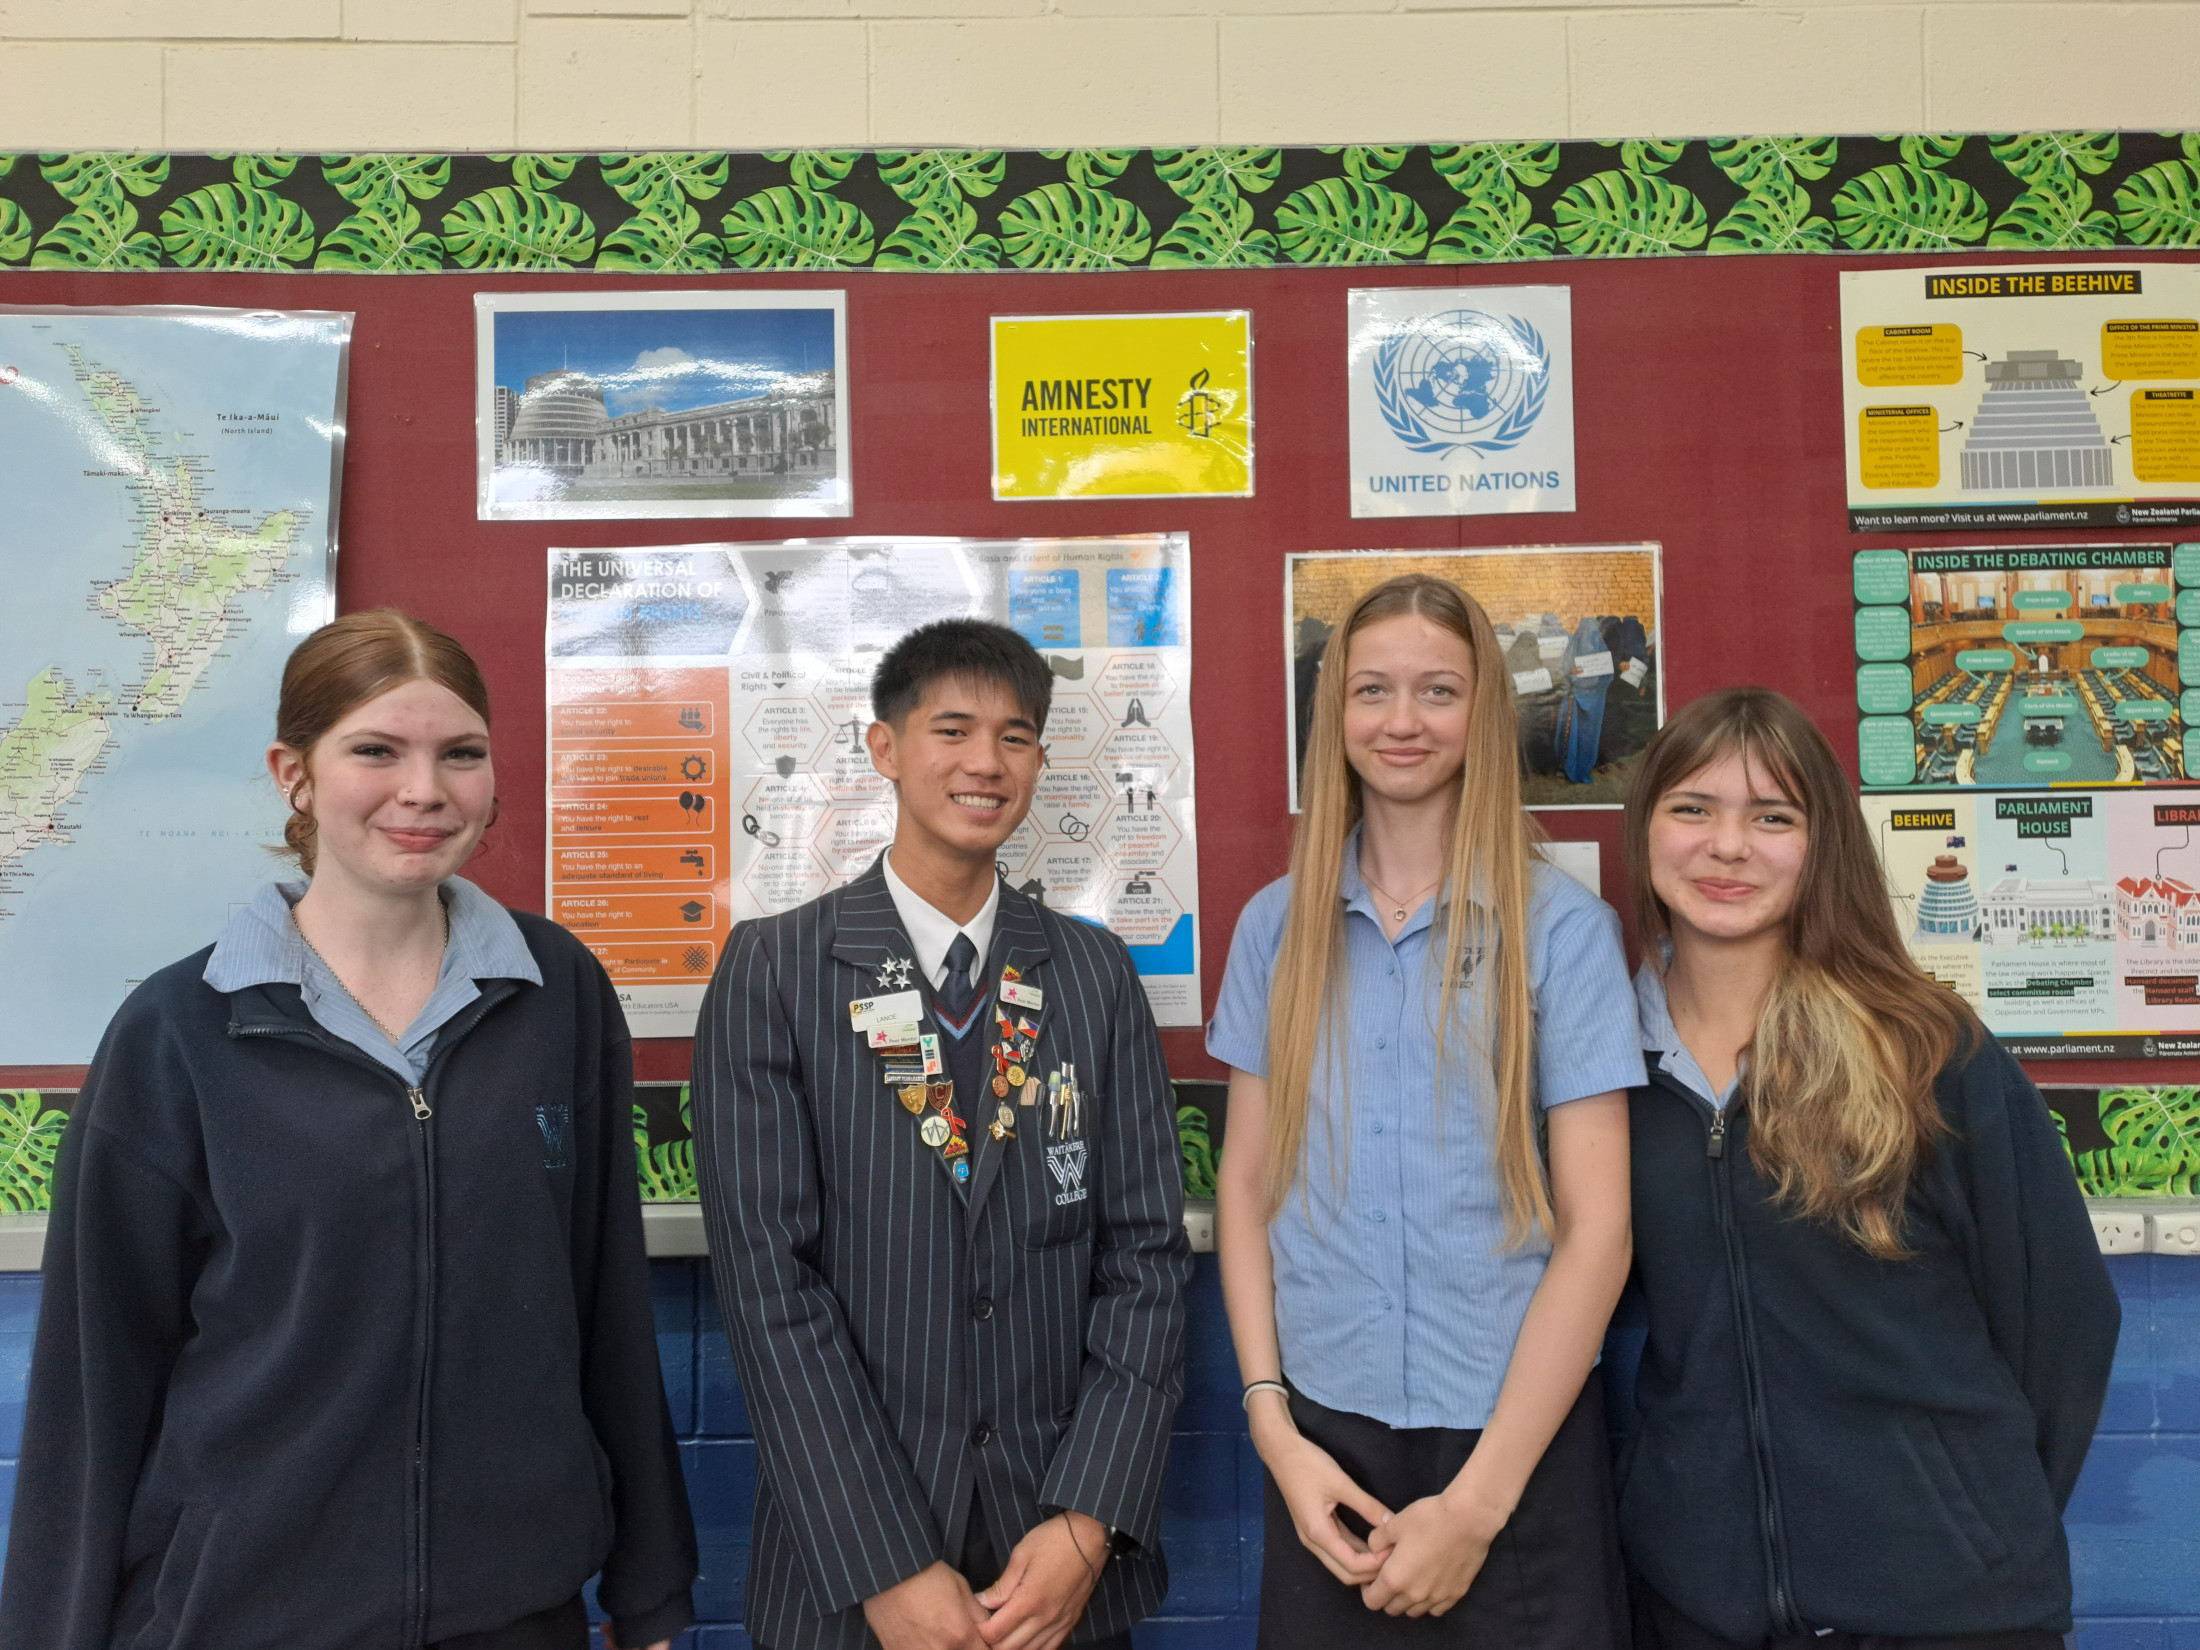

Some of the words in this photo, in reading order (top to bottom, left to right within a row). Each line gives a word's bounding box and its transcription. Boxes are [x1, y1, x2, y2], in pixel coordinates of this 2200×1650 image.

[1933, 277, 2000, 295] INSIDE
[2006, 276, 2045, 293] THE
[2052, 275, 2134, 292] BEEHIVE
[1022, 378, 1152, 411] AMNESTY
[1022, 416, 1152, 436] INTERNATIONAL
[1370, 475, 1451, 492] UNITED
[1460, 471, 1560, 491] NATIONS
[2132, 508, 2149, 516] New
[1855, 516, 1880, 525] Want
[1882, 516, 1892, 524] to
[1894, 515, 1918, 524] learn
[1921, 514, 1949, 523] more?
[1951, 512, 1972, 523] Visit
[1974, 514, 1985, 522] us
[1987, 514, 1996, 522] at
[1997, 511, 2088, 523] www.parliament.nz
[1918, 555, 1970, 569] INSIDE
[1974, 555, 2004, 568] THE
[2008, 552, 2087, 567] DEBATING
[2091, 551, 2165, 565] CHAMBER
[561, 561, 592, 577] THE
[599, 561, 697, 577] UNIVERSAL
[561, 583, 691, 599] DECLARATION
[698, 582, 723, 598] OF
[741, 671, 759, 679] Civil
[772, 671, 806, 679] Political
[741, 683, 767, 691] Rights
[774, 734, 797, 742] liberty
[1998, 801, 2090, 815] PARLIAMENT
[608, 815, 623, 823] right
[1894, 813, 1953, 827] BEEHIVE
[2020, 821, 2069, 834] HOUSE
[608, 863, 624, 871] right
[562, 872, 597, 881] adequate
[644, 871, 664, 879] living
[608, 911, 624, 919] right
[1135, 917, 1150, 925] part
[1991, 960, 2027, 968] Parliament
[2027, 978, 2059, 987] Debating
[2061, 978, 2092, 986] Chamber
[1990, 988, 2010, 997] select
[2012, 988, 2050, 996] committee
[854, 1002, 874, 1011] PSSP
[876, 1014, 896, 1022] LANCE
[2024, 1044, 2115, 1055] www.parliament.nz
[2158, 1042, 2175, 1050] New
[1047, 1141, 1084, 1155] WAITĀKERE
[1056, 1188, 1087, 1205] COLLEGE
